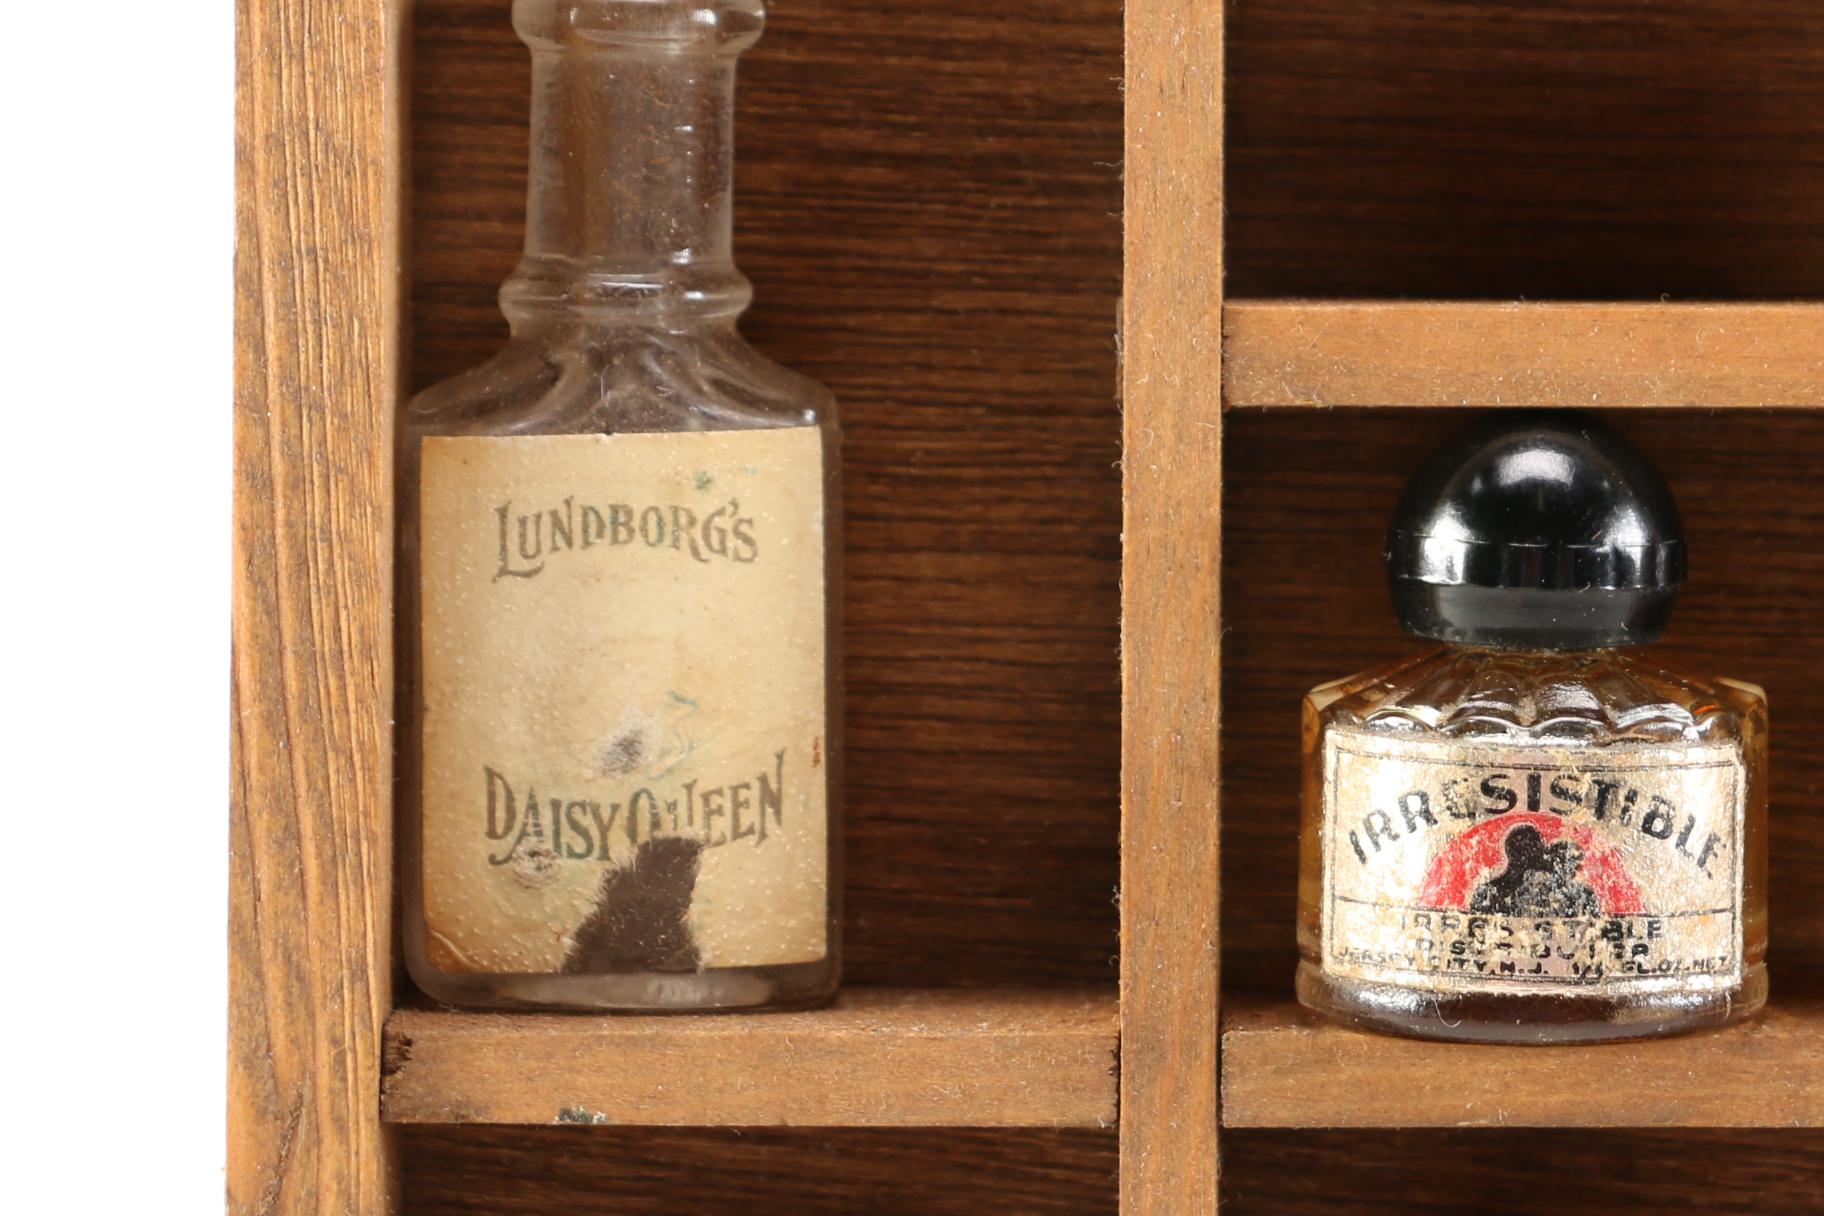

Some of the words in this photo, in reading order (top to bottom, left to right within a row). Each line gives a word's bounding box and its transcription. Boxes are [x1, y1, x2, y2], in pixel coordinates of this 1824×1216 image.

[493, 495, 758, 582] LUNDBORG'S
[483, 765, 621, 865] DAISY
[1349, 771, 1726, 879] IRRESISTIBLE
[1402, 912, 1662, 941] IRRESSTBLE
